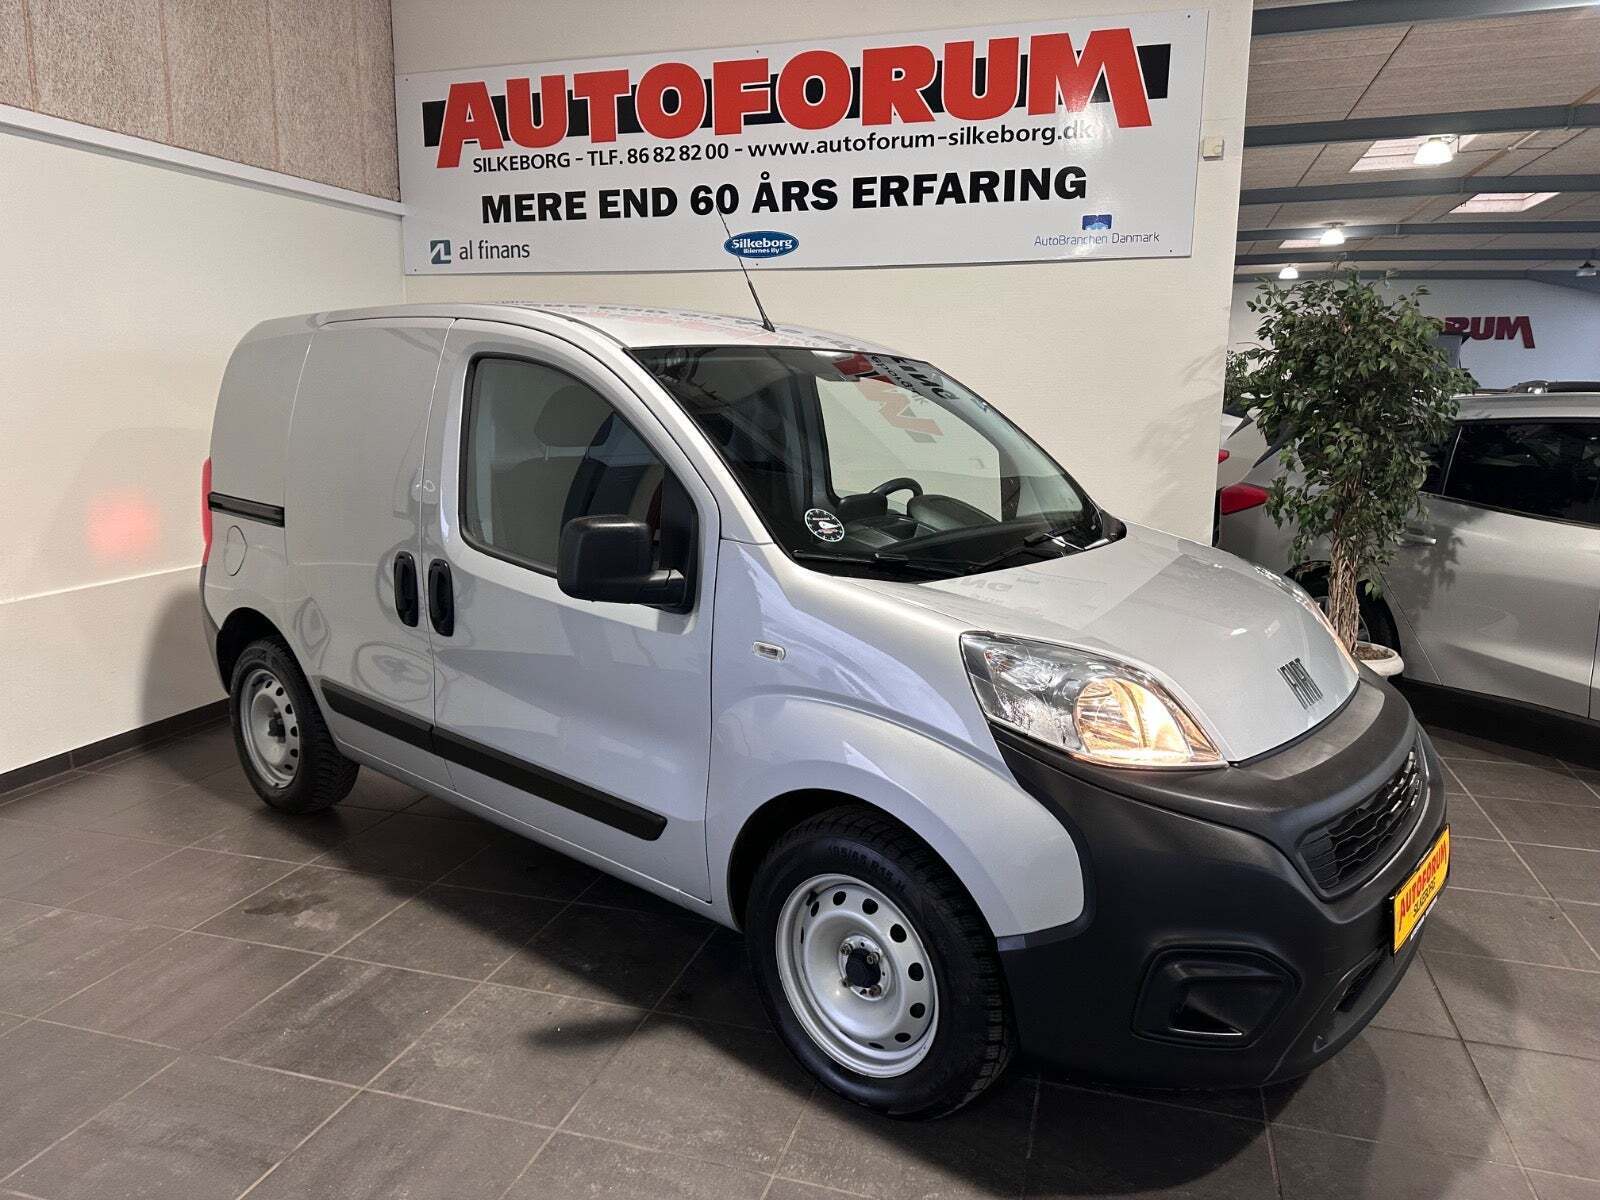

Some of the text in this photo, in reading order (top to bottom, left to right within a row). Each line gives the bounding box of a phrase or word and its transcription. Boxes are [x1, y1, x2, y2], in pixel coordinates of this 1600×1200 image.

[436, 27, 1153, 169] AUTOFORUM
[473, 152, 571, 173] SILKEBORG
[587, 150, 624, 167] TLF.
[627, 147, 649, 164] 86
[653, 145, 675, 162] 82
[679, 144, 701, 161] 82
[705, 143, 729, 160] 00
[748, 123, 1093, 157] www.autoforum-silkeborg.dk
[481, 165, 1087, 224] MERE END 60 ÅRS ERFARING
[459, 239, 530, 260] al finans
[731, 237, 793, 250] Silkeborg
[1034, 232, 1160, 247] AutoBranchen Danmark
[1399, 839, 1448, 932] AUTOFORUM
